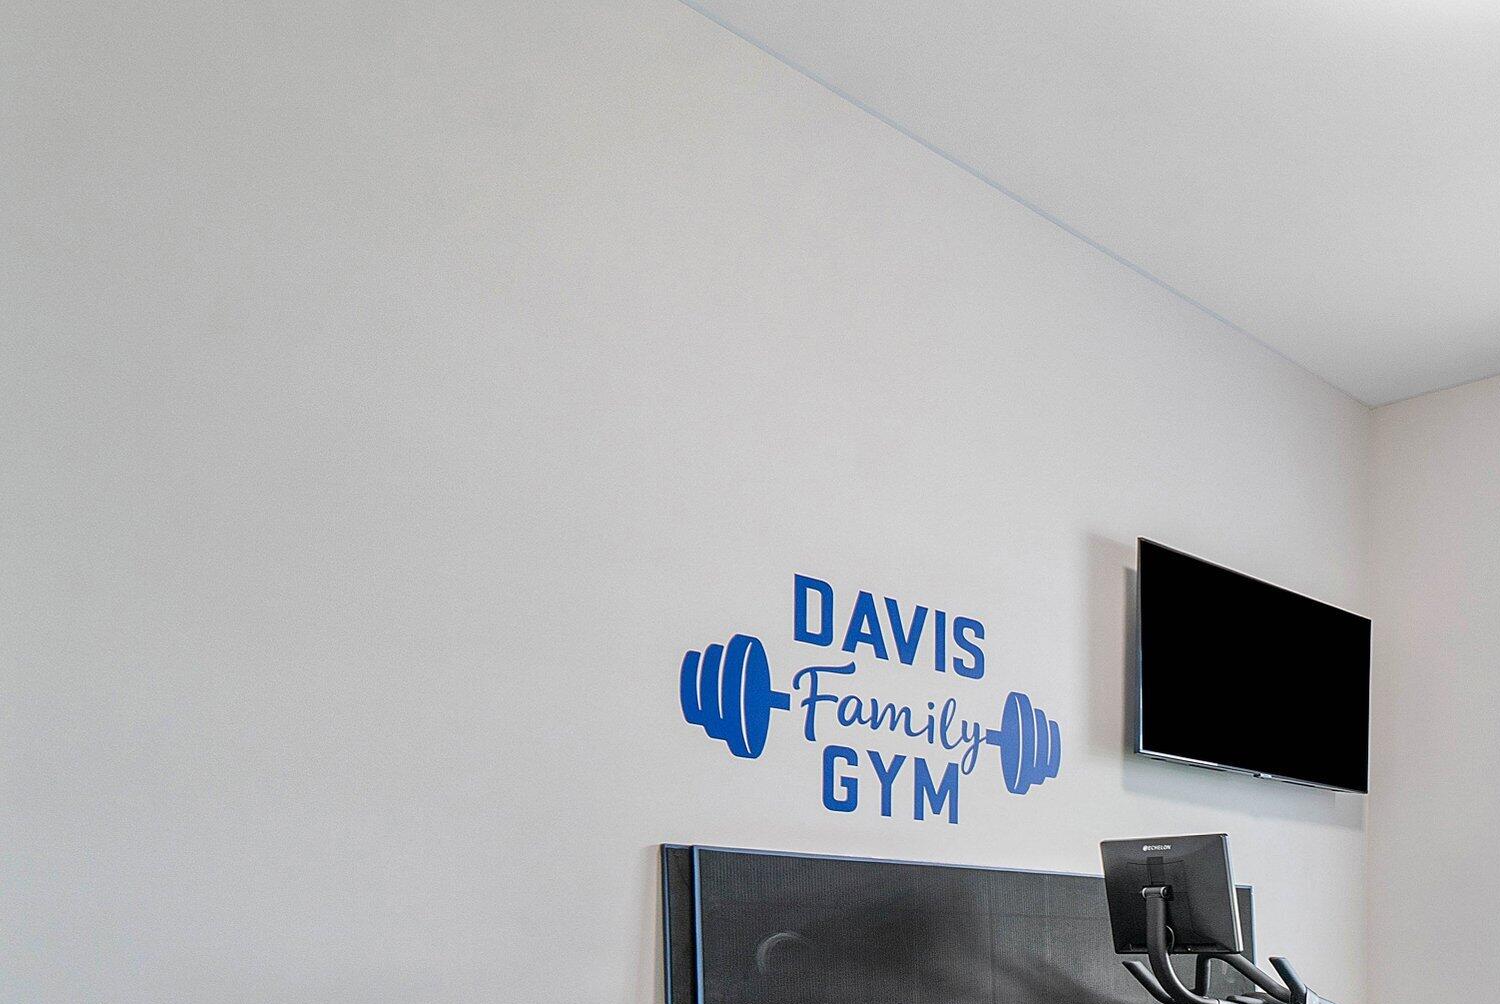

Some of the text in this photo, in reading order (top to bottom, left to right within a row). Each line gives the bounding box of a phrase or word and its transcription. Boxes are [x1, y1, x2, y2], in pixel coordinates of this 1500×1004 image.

[794, 574, 984, 679] DAVIS
[793, 661, 986, 775] Family
[822, 745, 959, 824] GYM
